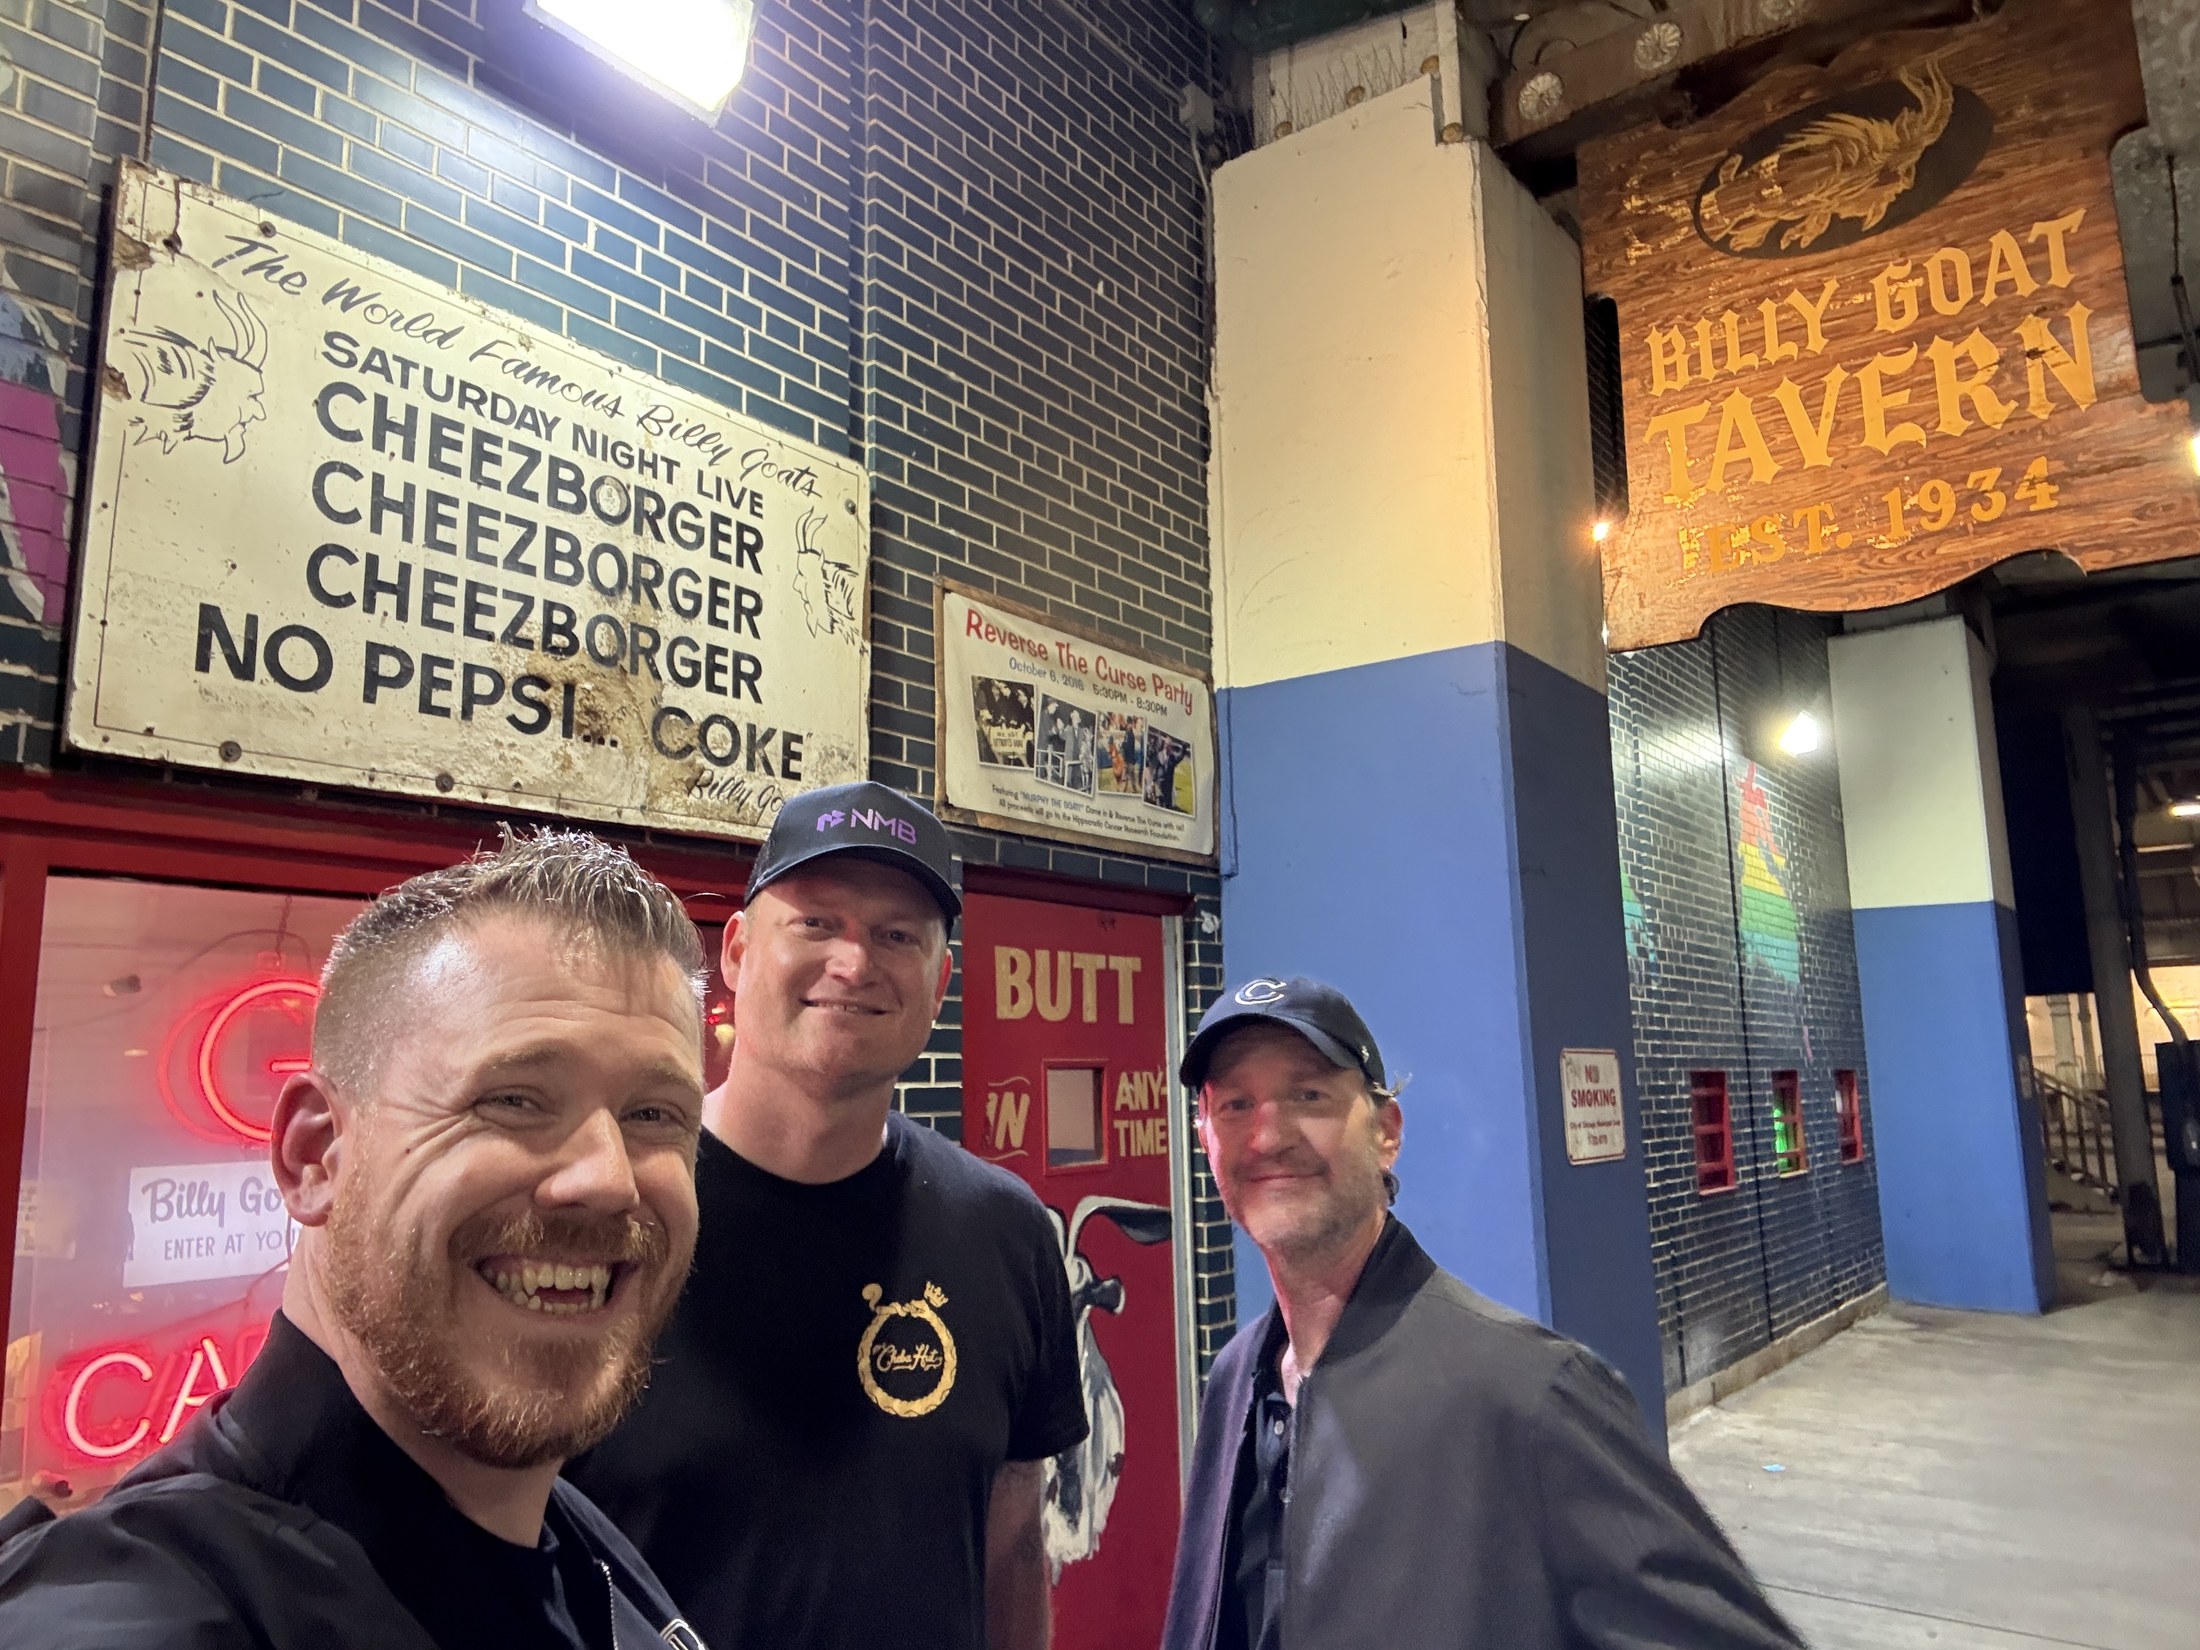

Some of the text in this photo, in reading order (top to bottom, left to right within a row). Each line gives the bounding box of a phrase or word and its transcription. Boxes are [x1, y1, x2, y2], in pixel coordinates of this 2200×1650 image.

[1644, 209, 2086, 397] BILLY GOAT
[212, 235, 822, 499] The World Famous Billy Goats
[1642, 301, 2098, 506] TAVERN
[315, 381, 764, 575] CHEEZBORGER
[321, 331, 764, 519] SATURDAY NIGHT LIVE
[312, 460, 763, 639] CHEEZBORGER
[1707, 455, 2060, 573] EST. 1934
[195, 602, 334, 692] NO
[362, 640, 618, 747] PEPSI...
[306, 543, 763, 704] CHEEZBORGER
[966, 608, 1193, 717] Reverse The Curse Party
[1009, 656, 1047, 678] October
[1092, 683, 1128, 705] 5:30PM
[1136, 697, 1168, 716] 8:30PM
[687, 768, 753, 815] Billy
[850, 808, 917, 845] NMB
[994, 945, 1142, 1024] BUTT
[985, 1091, 1031, 1150] IN
[1114, 1118, 1168, 1157] TIME
[1571, 1088, 1617, 1109] SMOKING
[142, 1178, 226, 1229] Billy
[164, 1236, 216, 1261] ENTER
[224, 1233, 245, 1255] AT
